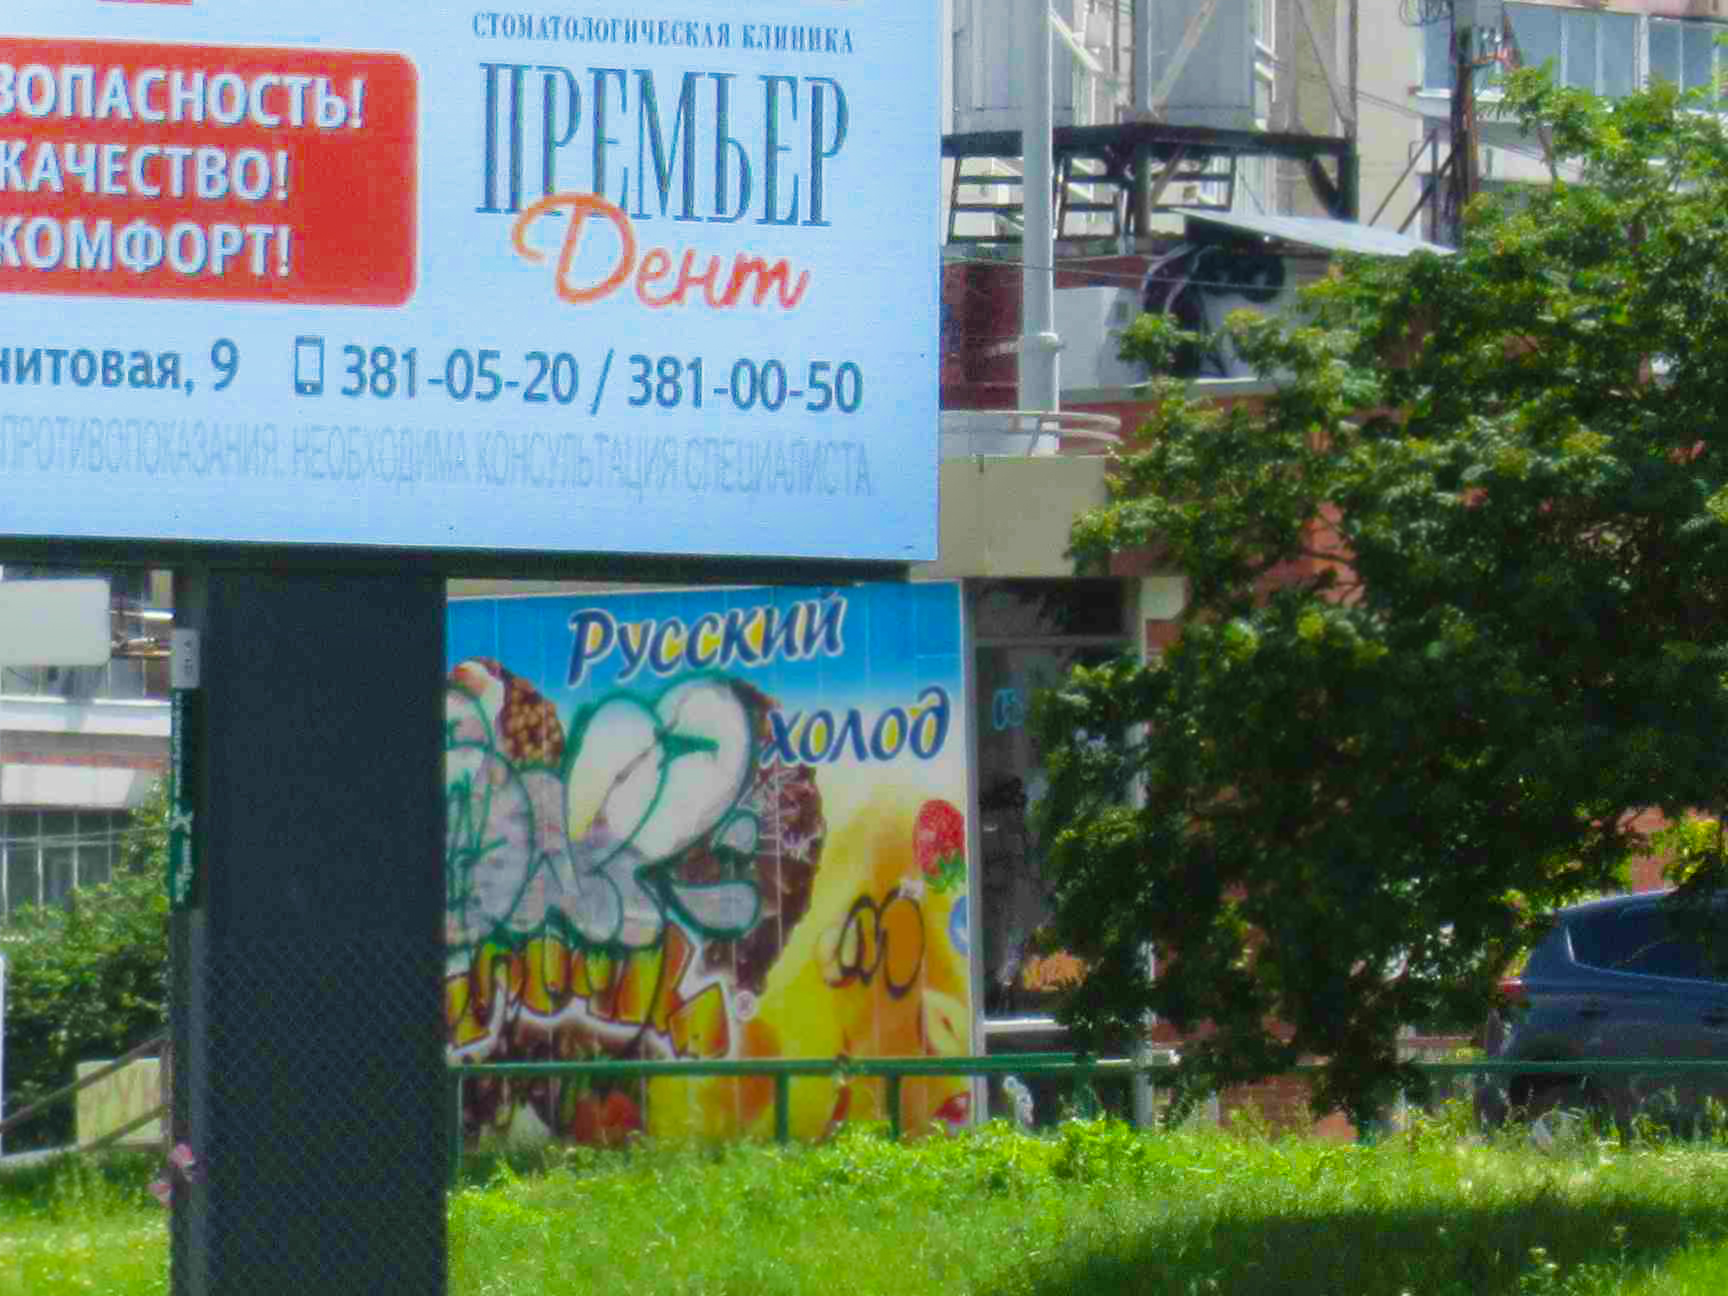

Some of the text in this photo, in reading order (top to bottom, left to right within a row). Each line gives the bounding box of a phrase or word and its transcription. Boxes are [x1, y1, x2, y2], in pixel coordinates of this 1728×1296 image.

[472, 12, 855, 54] СТОМАТОЛОГИЧЕСКАЯ КЛИНИКА
[474, 62, 849, 227] ПРЕМЬЕР
[511, 191, 811, 310] Дент
[210, 337, 241, 391] 9
[340, 343, 580, 404] 381-05-20
[627, 354, 865, 414] 381-00-50
[568, 591, 847, 687] Русский
